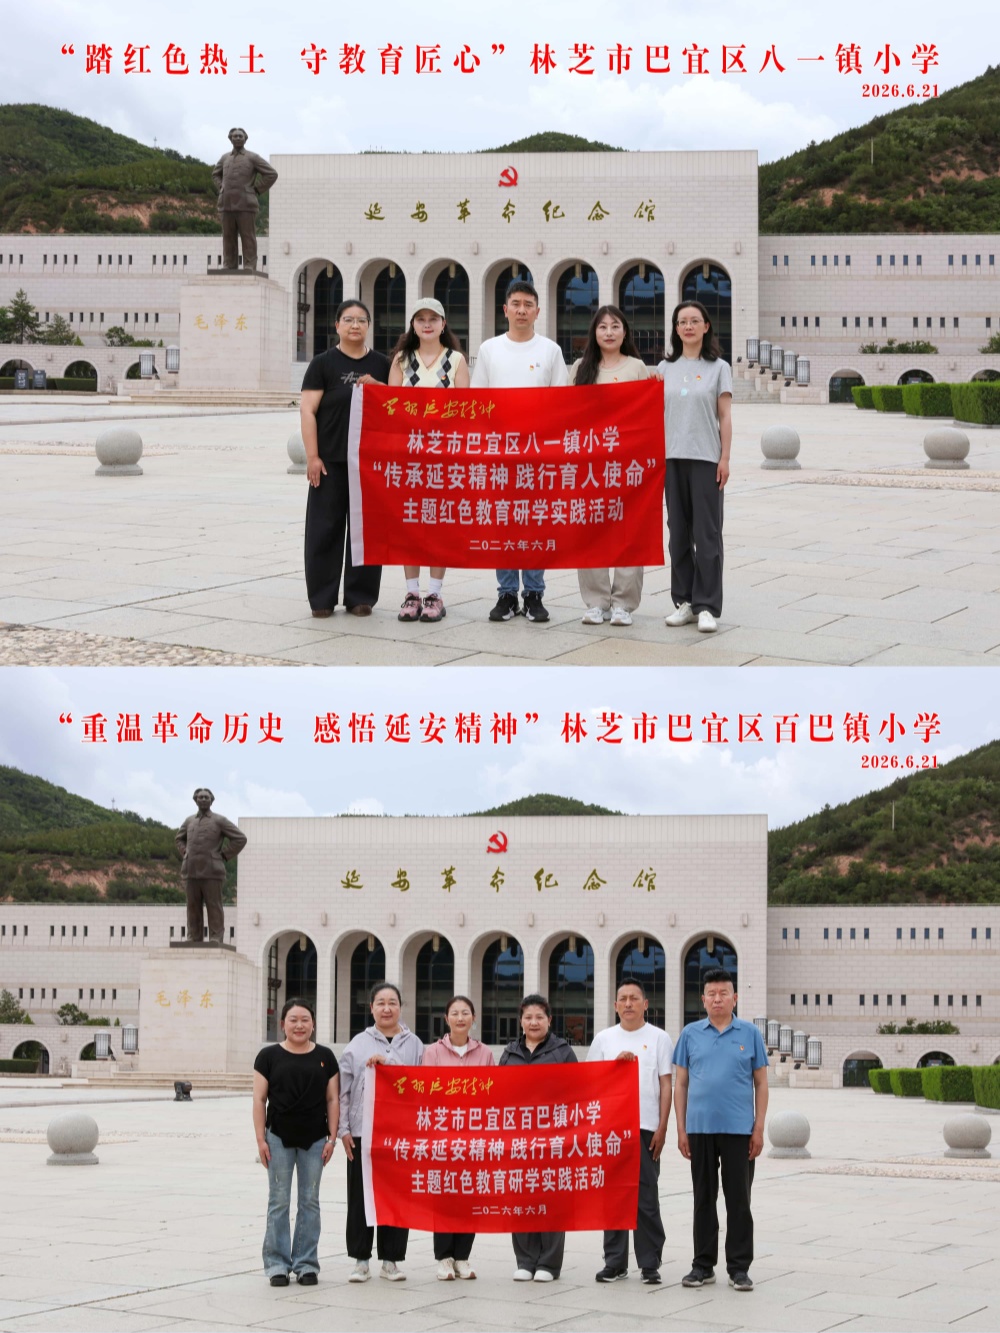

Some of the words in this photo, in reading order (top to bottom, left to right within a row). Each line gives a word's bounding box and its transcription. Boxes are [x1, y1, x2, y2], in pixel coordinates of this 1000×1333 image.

[365, 198, 656, 223] 延安革命纪念馆
[193, 313, 247, 331] 毛泽东
[406, 426, 620, 455] 林芝市巴宜区八一镇小学
[402, 497, 624, 526] 主题红色教育研学实践活动
[340, 866, 658, 893] 延安革命纪念馆
[155, 989, 214, 1008] 毛泽东
[416, 1100, 601, 1132] 林芝市巴宜区百巴镇小学
[411, 1165, 605, 1195] 主题红色教育研学实践活动
